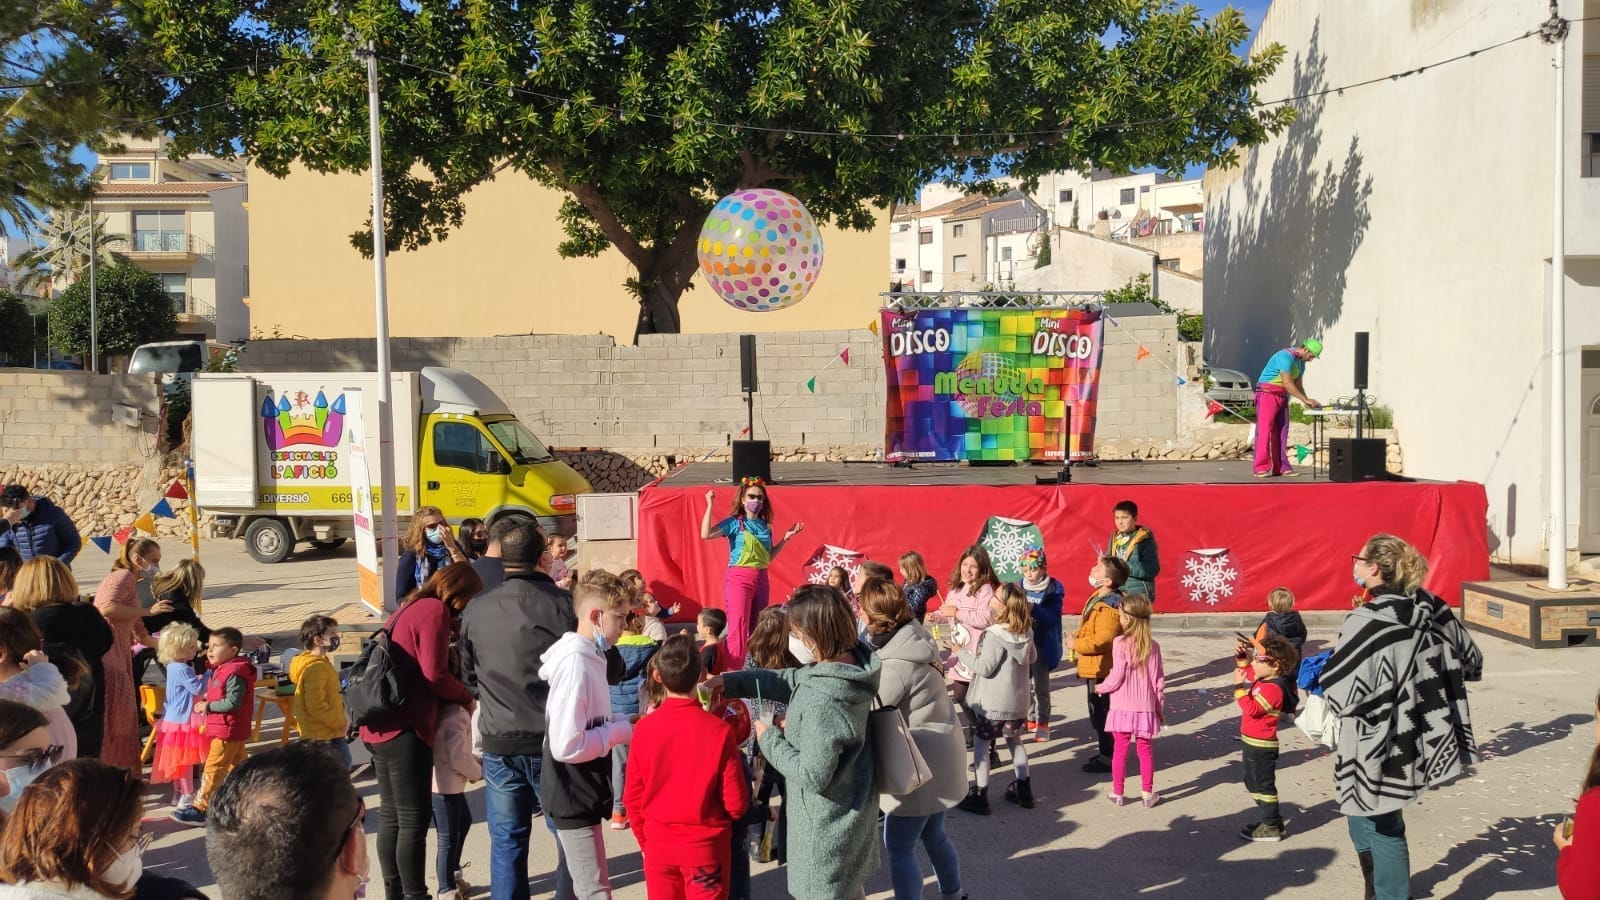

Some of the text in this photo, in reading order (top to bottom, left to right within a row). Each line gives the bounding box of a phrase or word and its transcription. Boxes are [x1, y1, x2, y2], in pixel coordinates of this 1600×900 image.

[1040, 317, 1060, 329] Mini
[891, 328, 950, 357] DISCO
[1033, 331, 1092, 359] DISCO
[935, 370, 1044, 394] Menuda
[271, 451, 338, 461] ESPECTACLES
[263, 492, 310, 503] DIVERSIÓ
